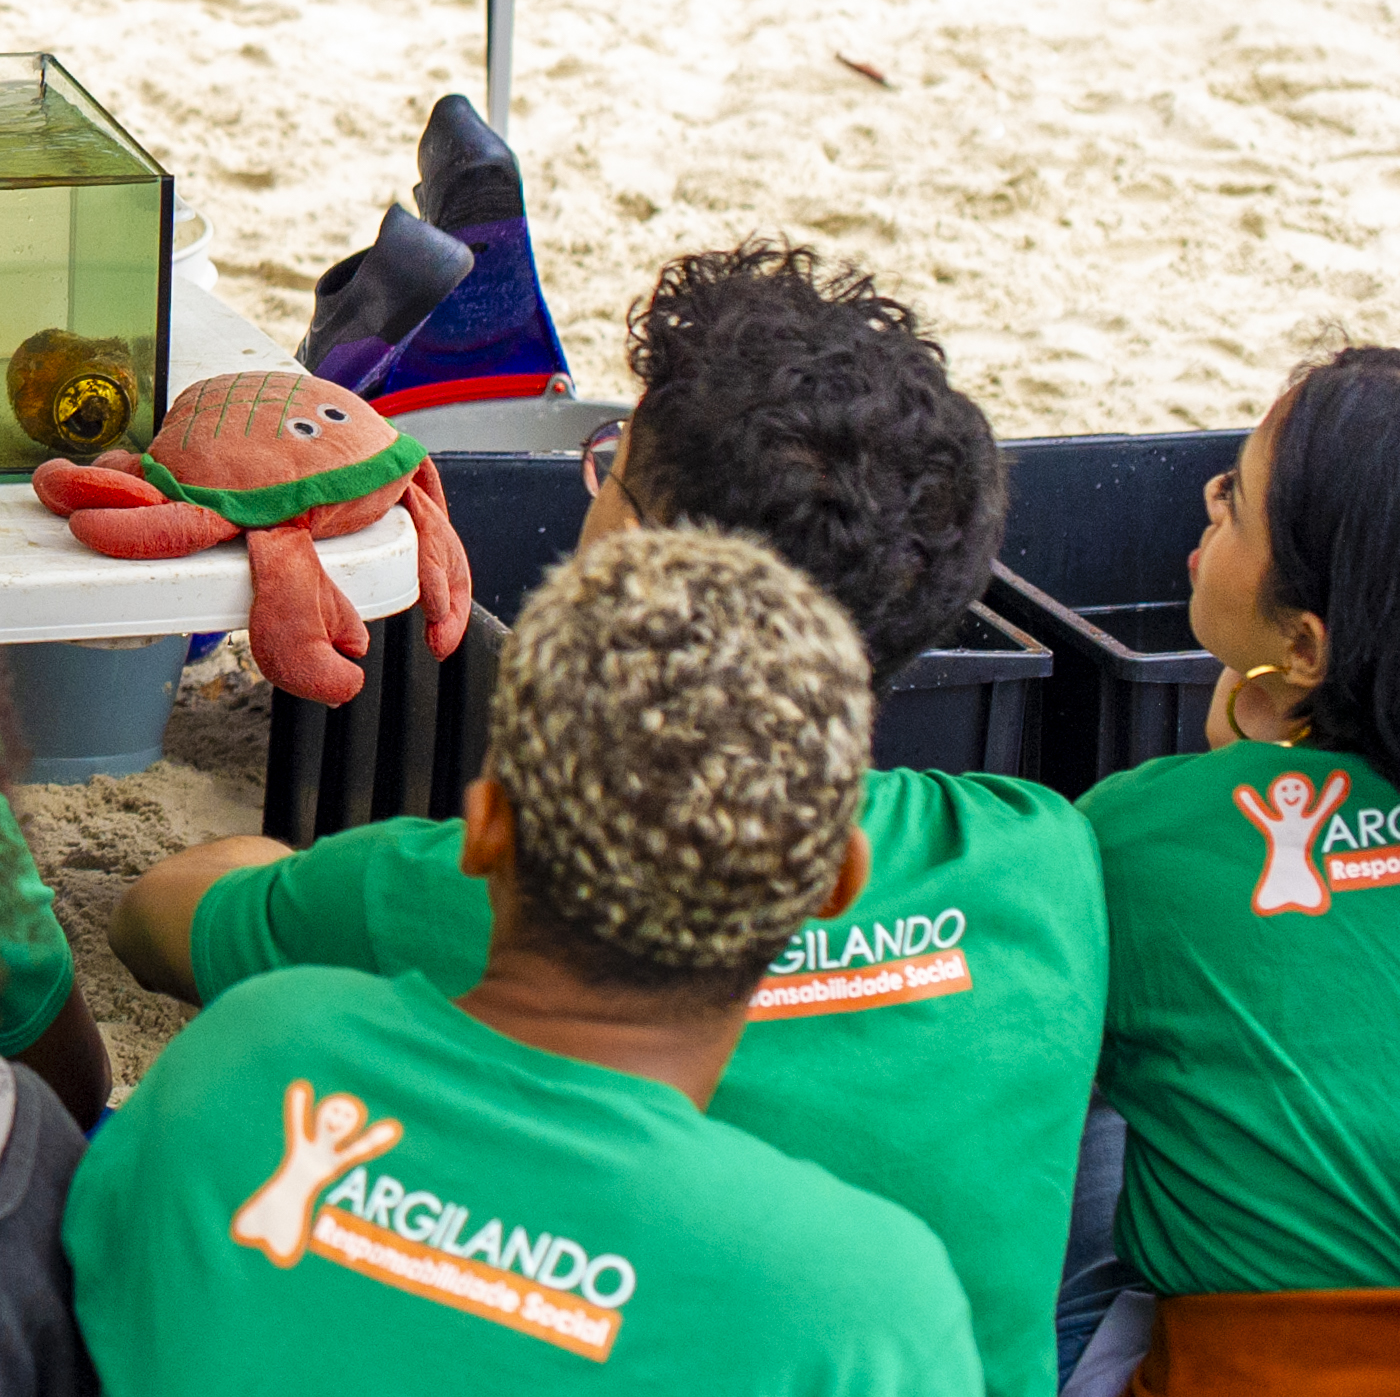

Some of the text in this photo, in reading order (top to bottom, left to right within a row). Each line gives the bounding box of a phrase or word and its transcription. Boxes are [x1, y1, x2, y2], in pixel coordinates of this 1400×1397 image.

[904, 954, 965, 988] Social
[313, 1214, 610, 1348] Responsabilidade Social
[325, 1165, 636, 1309] ARGILANDO
